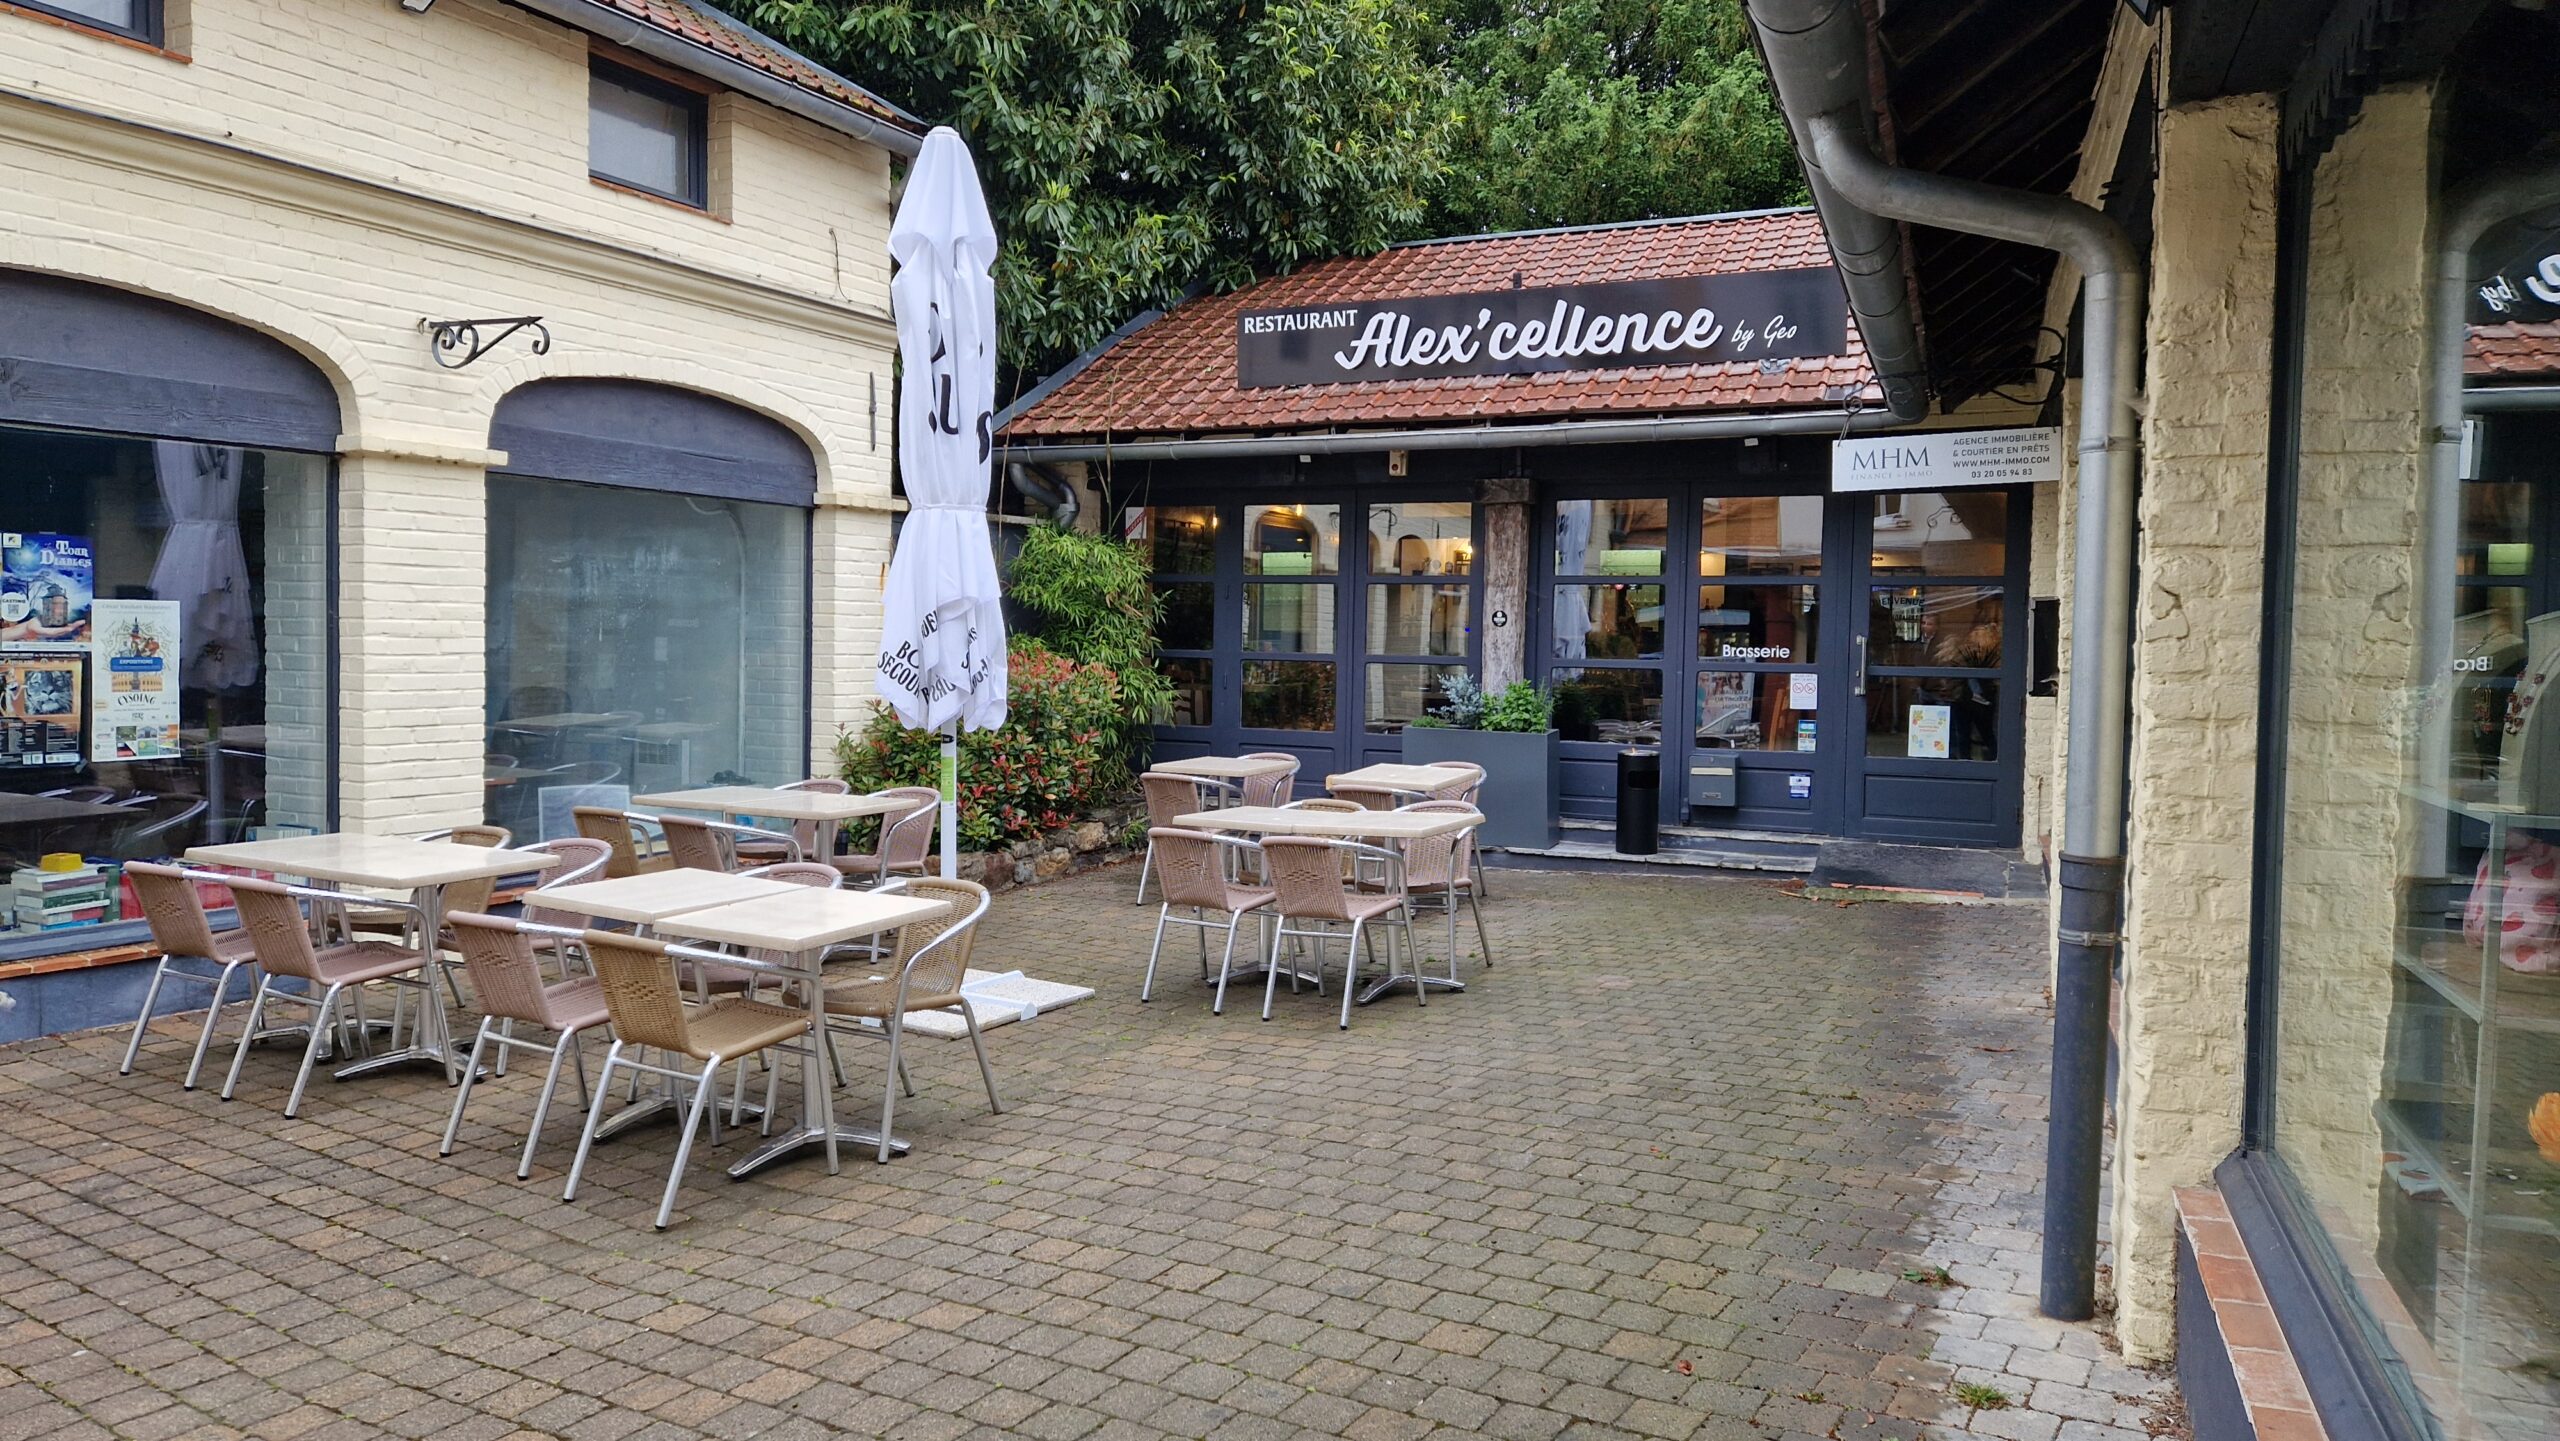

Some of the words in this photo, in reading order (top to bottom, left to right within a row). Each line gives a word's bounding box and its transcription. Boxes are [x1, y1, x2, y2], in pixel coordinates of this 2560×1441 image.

[1244, 309, 1357, 334] RESTAURANT
[1334, 299, 1723, 370] Alex'cellence
[1731, 323, 1755, 352] by
[1763, 314, 1799, 341] Geo
[1953, 437, 1988, 446] AGENCE
[1991, 431, 2050, 444] IMMOBILIÈRE
[1952, 449, 1959, 457] &
[1961, 446, 2004, 457] COURTIER
[2006, 445, 2018, 454] EN
[2021, 443, 2050, 453] PRÊTS
[1853, 446, 1932, 470] MHM
[1953, 455, 2050, 468] WWW.MHM-IMMO.COM
[1905, 470, 1933, 478] IMMO
[1984, 470, 1995, 478] 20
[1996, 469, 2008, 477] 05
[2009, 468, 2020, 476] 94
[1722, 644, 1790, 658] Brasserie
[117, 693, 156, 706] CYSOING
